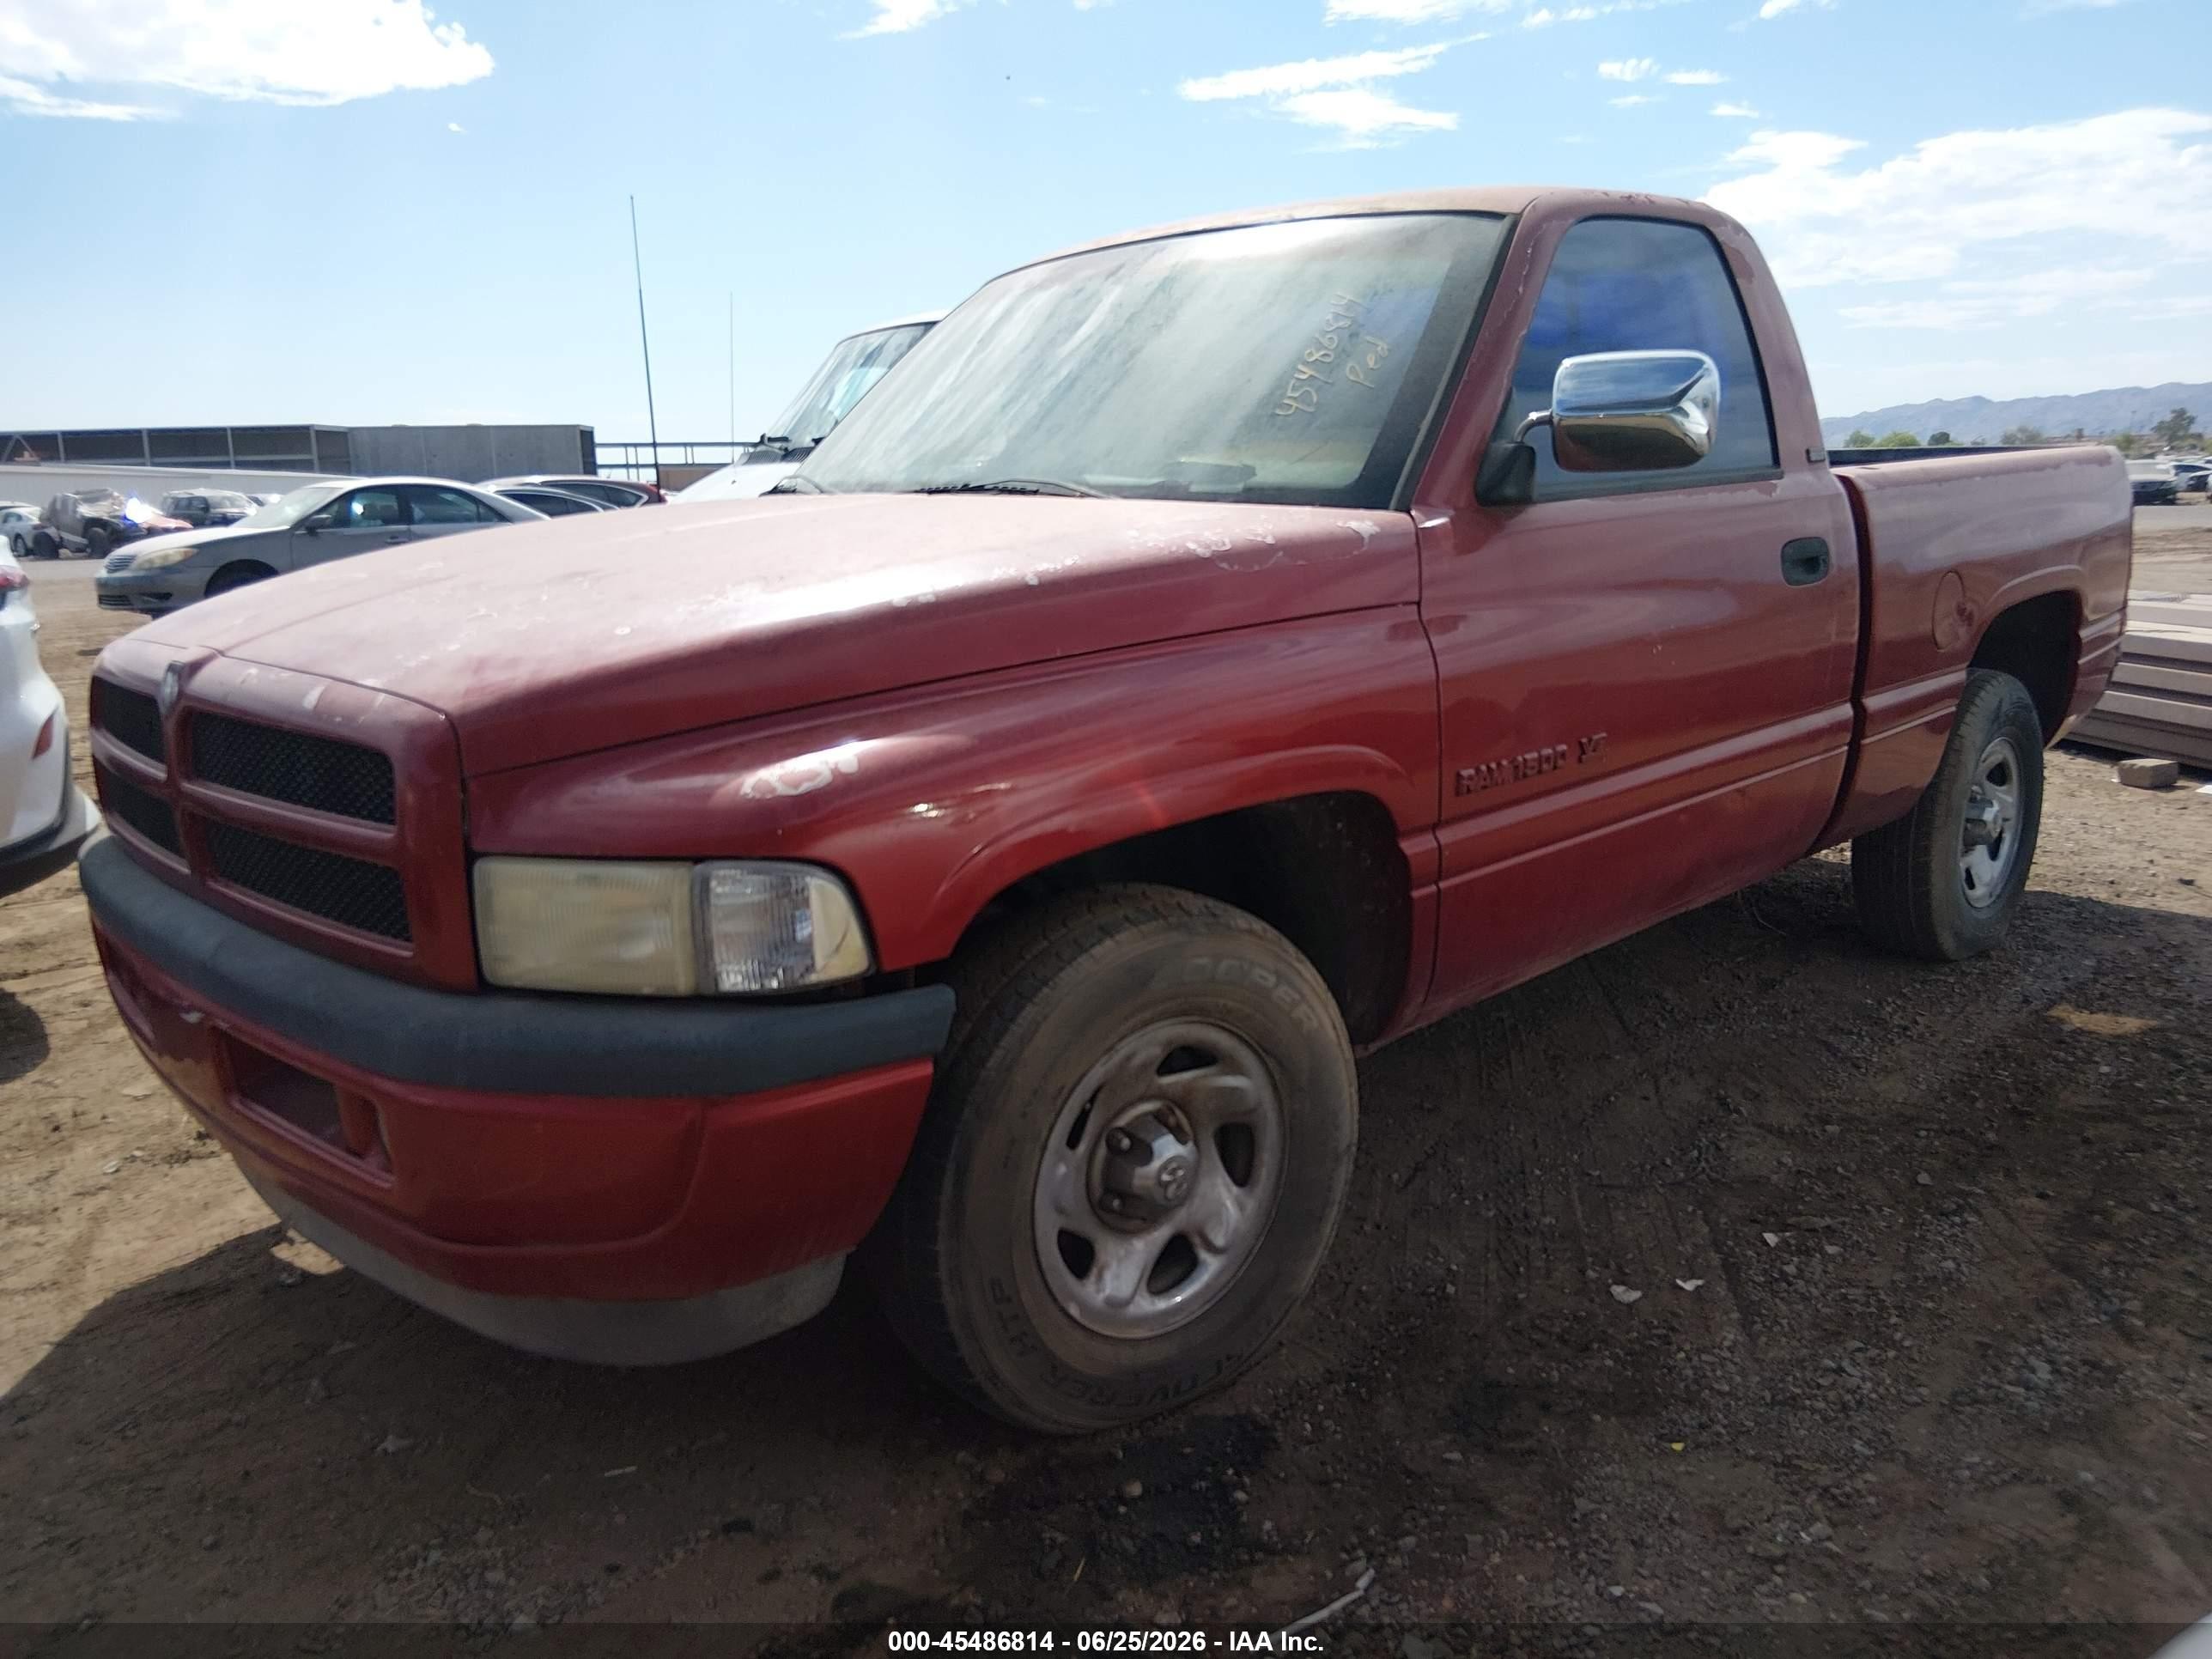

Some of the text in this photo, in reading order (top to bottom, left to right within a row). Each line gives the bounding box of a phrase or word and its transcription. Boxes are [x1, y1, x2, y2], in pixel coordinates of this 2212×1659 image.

[1274, 292, 1371, 416] 45486814
[1455, 759, 1514, 797] RAM
[1513, 744, 1568, 780] 1500
